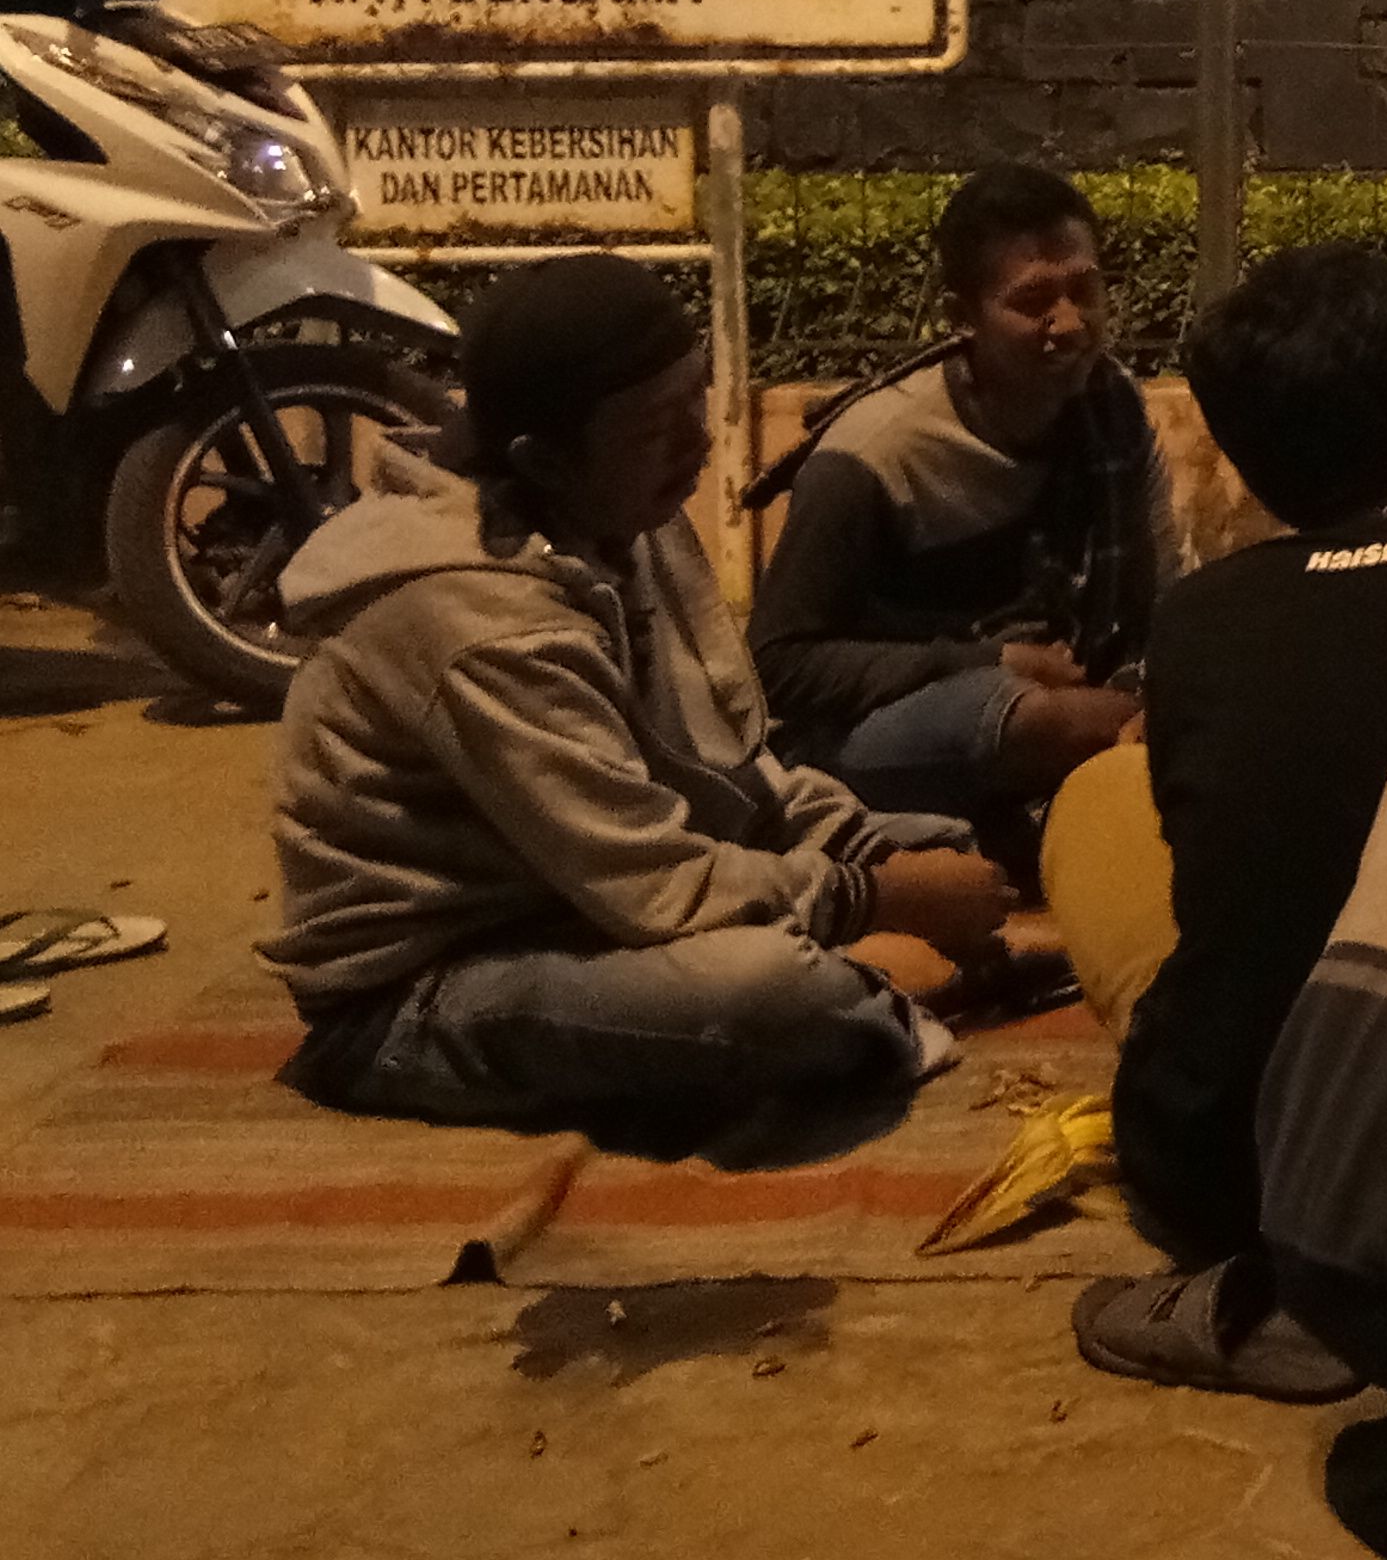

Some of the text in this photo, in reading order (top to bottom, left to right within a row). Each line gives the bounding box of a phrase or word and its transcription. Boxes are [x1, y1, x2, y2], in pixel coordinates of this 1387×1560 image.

[353, 125, 680, 161] KANTOR KEBERSIHAN
[380, 168, 654, 205] DAN PERTAMANAN
